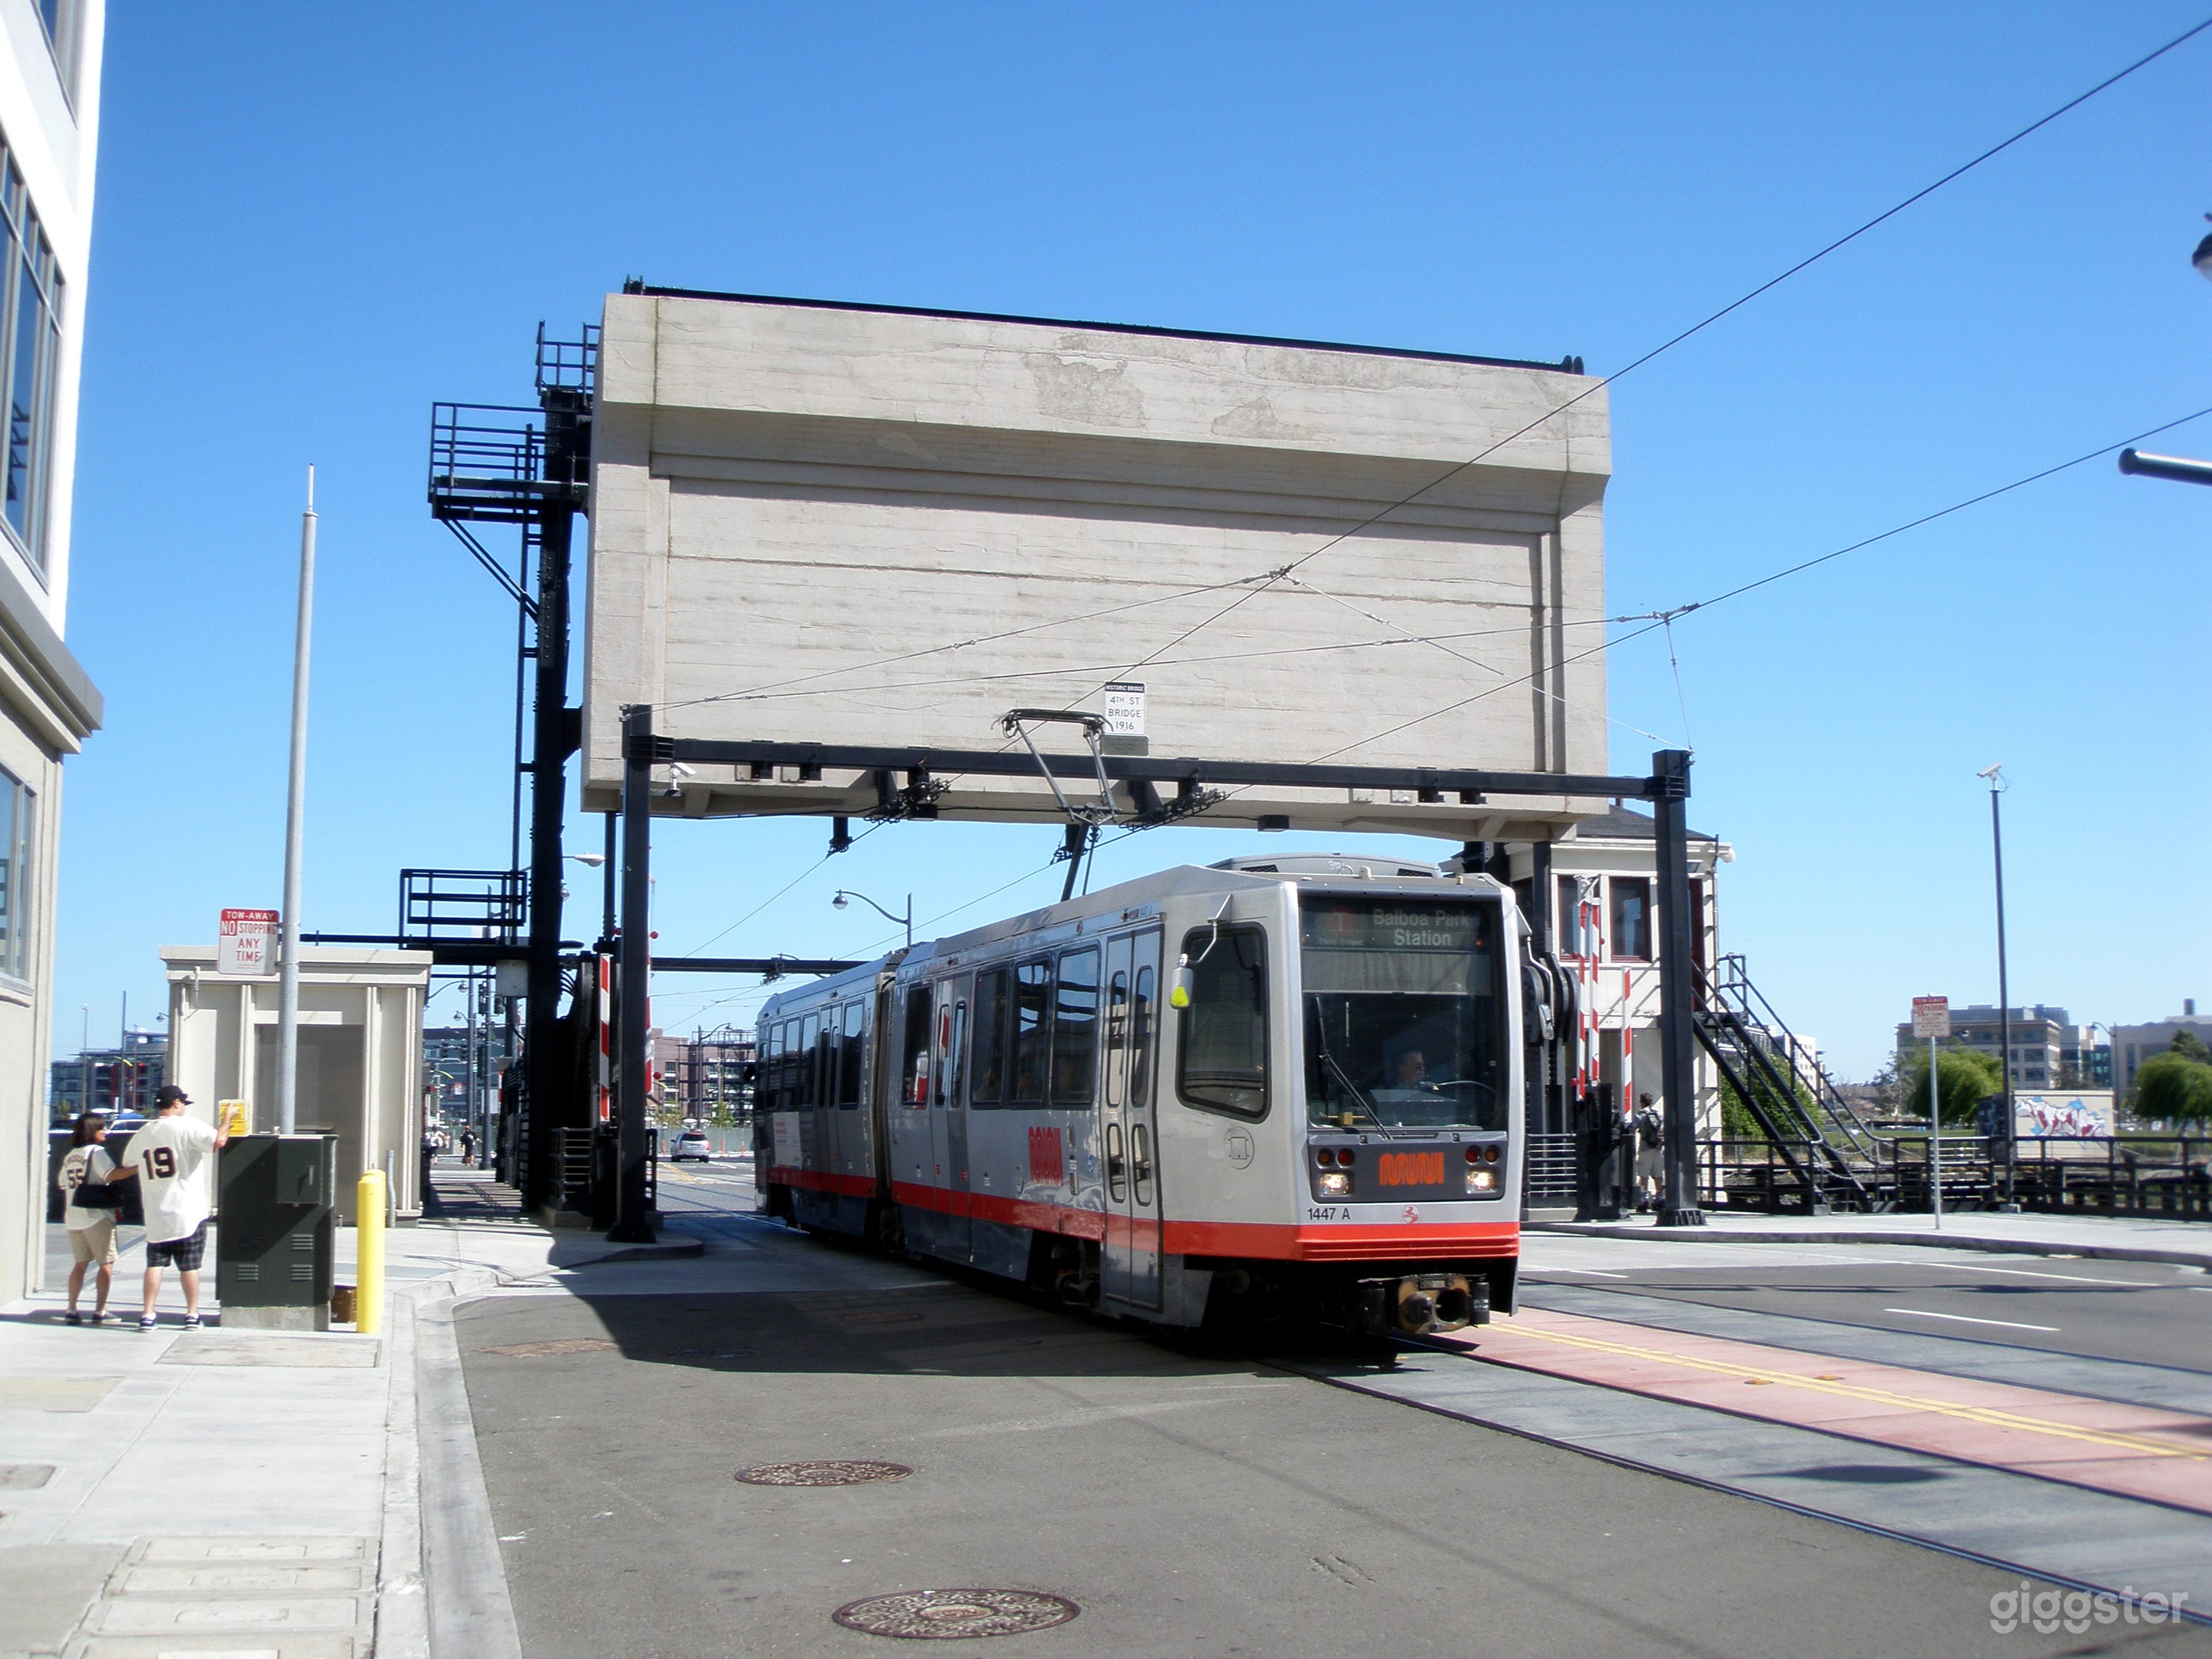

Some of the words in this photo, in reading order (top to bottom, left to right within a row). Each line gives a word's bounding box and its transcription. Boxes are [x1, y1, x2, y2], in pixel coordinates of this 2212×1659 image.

[1129, 697, 1141, 705] ST
[1108, 708, 1141, 717] BRIDGE
[1115, 721, 1134, 730] 1916
[227, 911, 274, 920] TOW-AWAY
[1373, 909, 1428, 926] Balboa
[1435, 909, 1469, 927] Park
[220, 920, 237, 935] NO
[239, 922, 277, 935] STOPPING
[237, 938, 261, 949] ANY
[1394, 929, 1451, 946] Station
[236, 950, 261, 962] TIME
[143, 1147, 176, 1180] 19
[67, 1167, 84, 1189] 55
[1307, 1207, 1336, 1220] 1447
[1342, 1207, 1350, 1220] A
